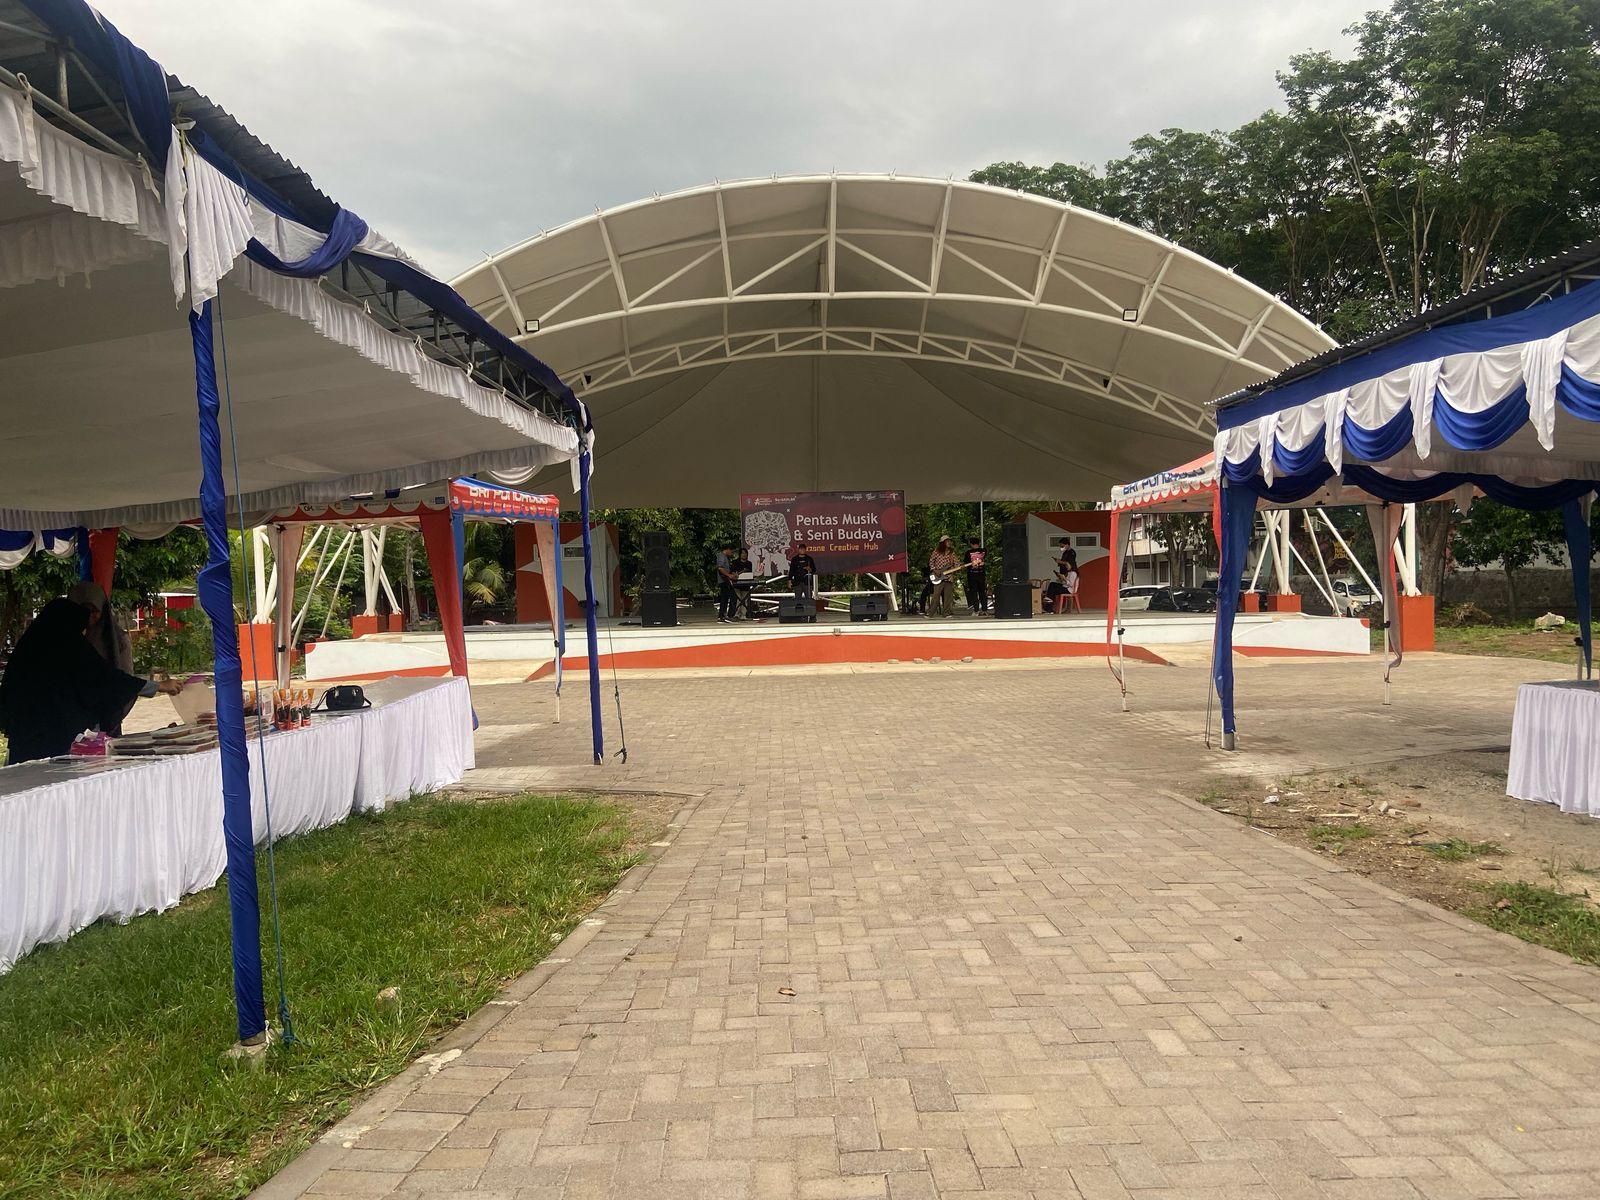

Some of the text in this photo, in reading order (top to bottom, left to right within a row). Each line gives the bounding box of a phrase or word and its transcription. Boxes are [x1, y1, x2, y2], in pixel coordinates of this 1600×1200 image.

[796, 512, 879, 526] Pentas Musik
[794, 527, 883, 542] & Seni Budaya
[829, 543, 859, 552] Creative
[864, 542, 879, 551] Hub
